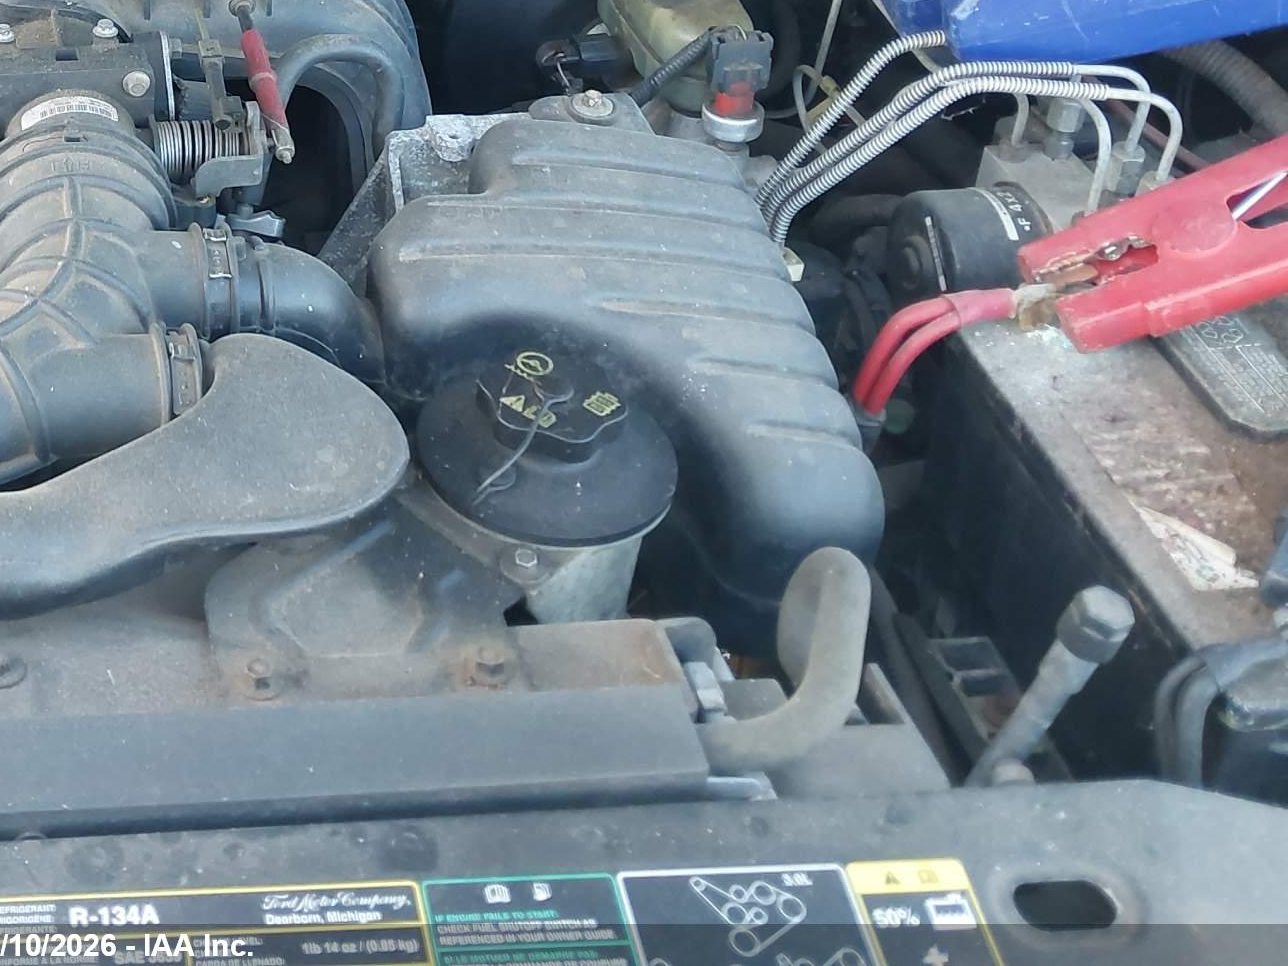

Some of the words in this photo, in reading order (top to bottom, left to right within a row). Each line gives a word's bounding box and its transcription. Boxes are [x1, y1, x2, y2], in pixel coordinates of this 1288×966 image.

[262, 894, 297, 911] Ford
[295, 892, 339, 913] Motor
[69, 904, 159, 927] R-134A
[265, 911, 325, 926] Dearborn,
[327, 909, 382, 925] Michigan
[436, 924, 470, 935] CHECK
[472, 922, 497, 933] FUEL
[516, 932, 545, 943] YOUR
